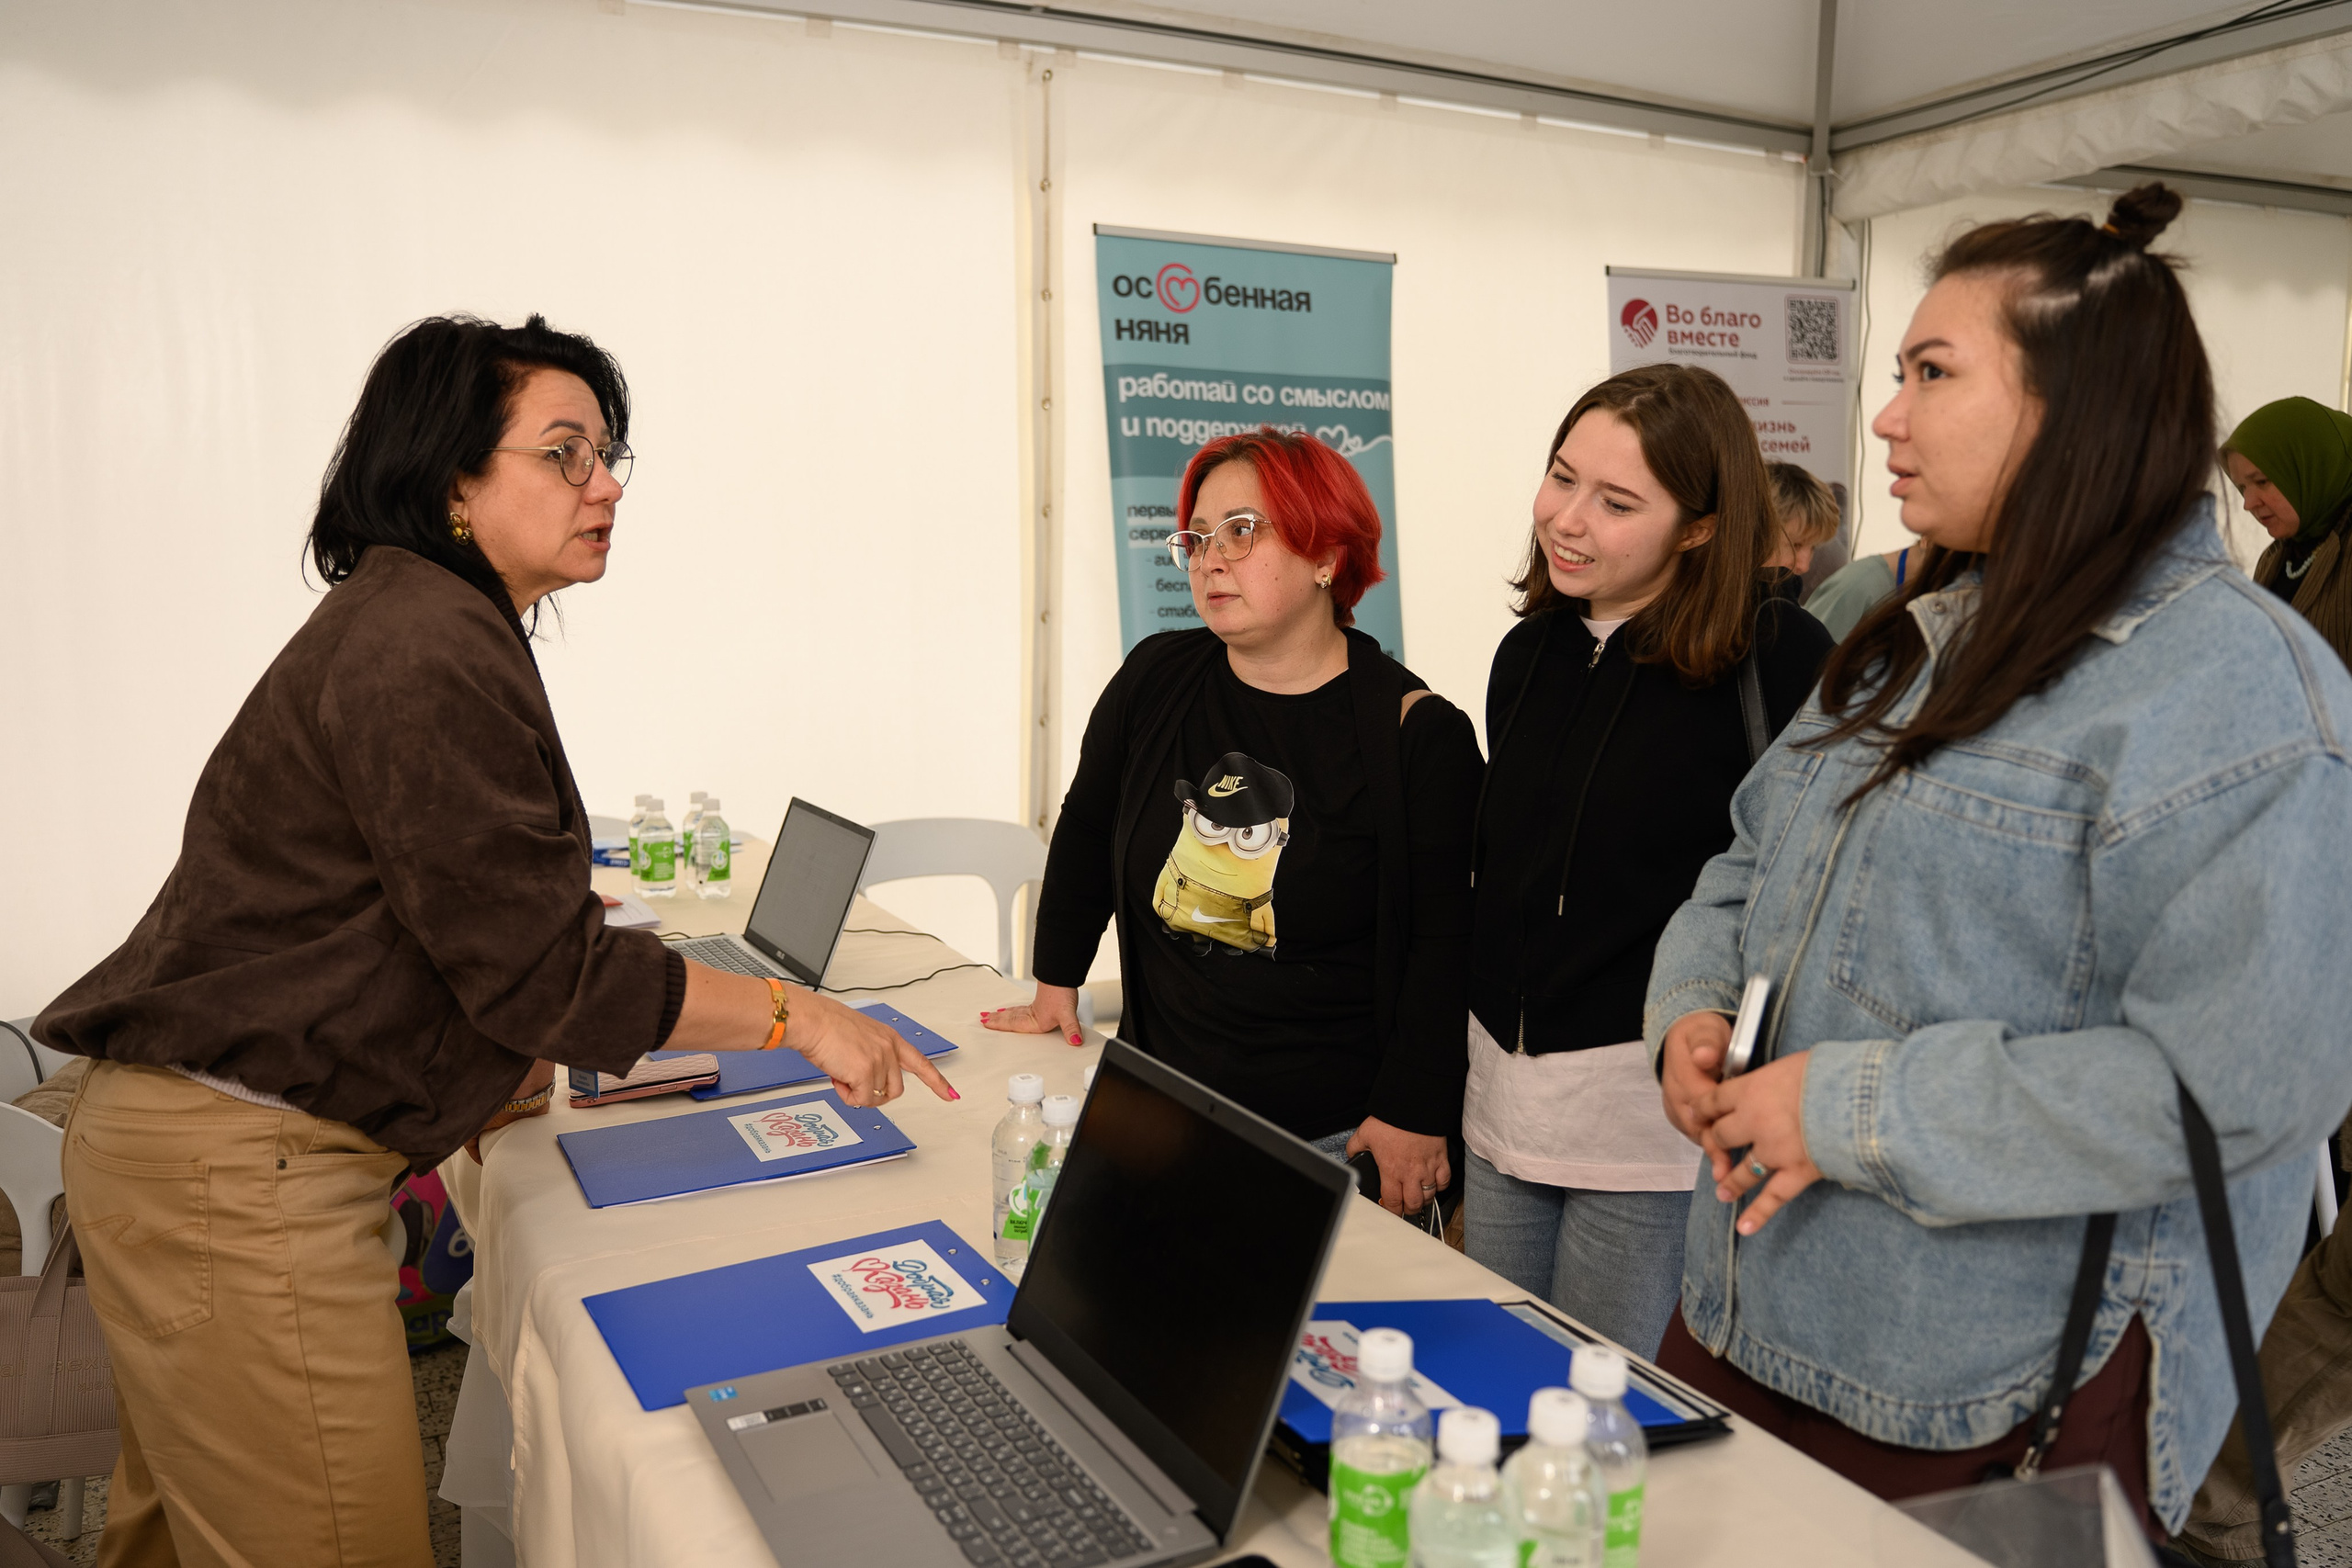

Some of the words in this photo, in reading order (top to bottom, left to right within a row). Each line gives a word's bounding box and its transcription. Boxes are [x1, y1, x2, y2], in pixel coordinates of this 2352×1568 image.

[1666, 303, 1693, 324] Во
[1700, 306, 1762, 329] благо
[1114, 319, 1190, 345] няня
[1667, 330, 1740, 348] вместе
[1118, 373, 1238, 403] работай
[1242, 385, 1274, 405] со
[1280, 387, 1391, 412] смыслом
[1760, 435, 1811, 453] семей
[1127, 504, 1178, 520] первы
[1128, 529, 1172, 544] серв
[1218, 774, 1243, 791] NIKE
